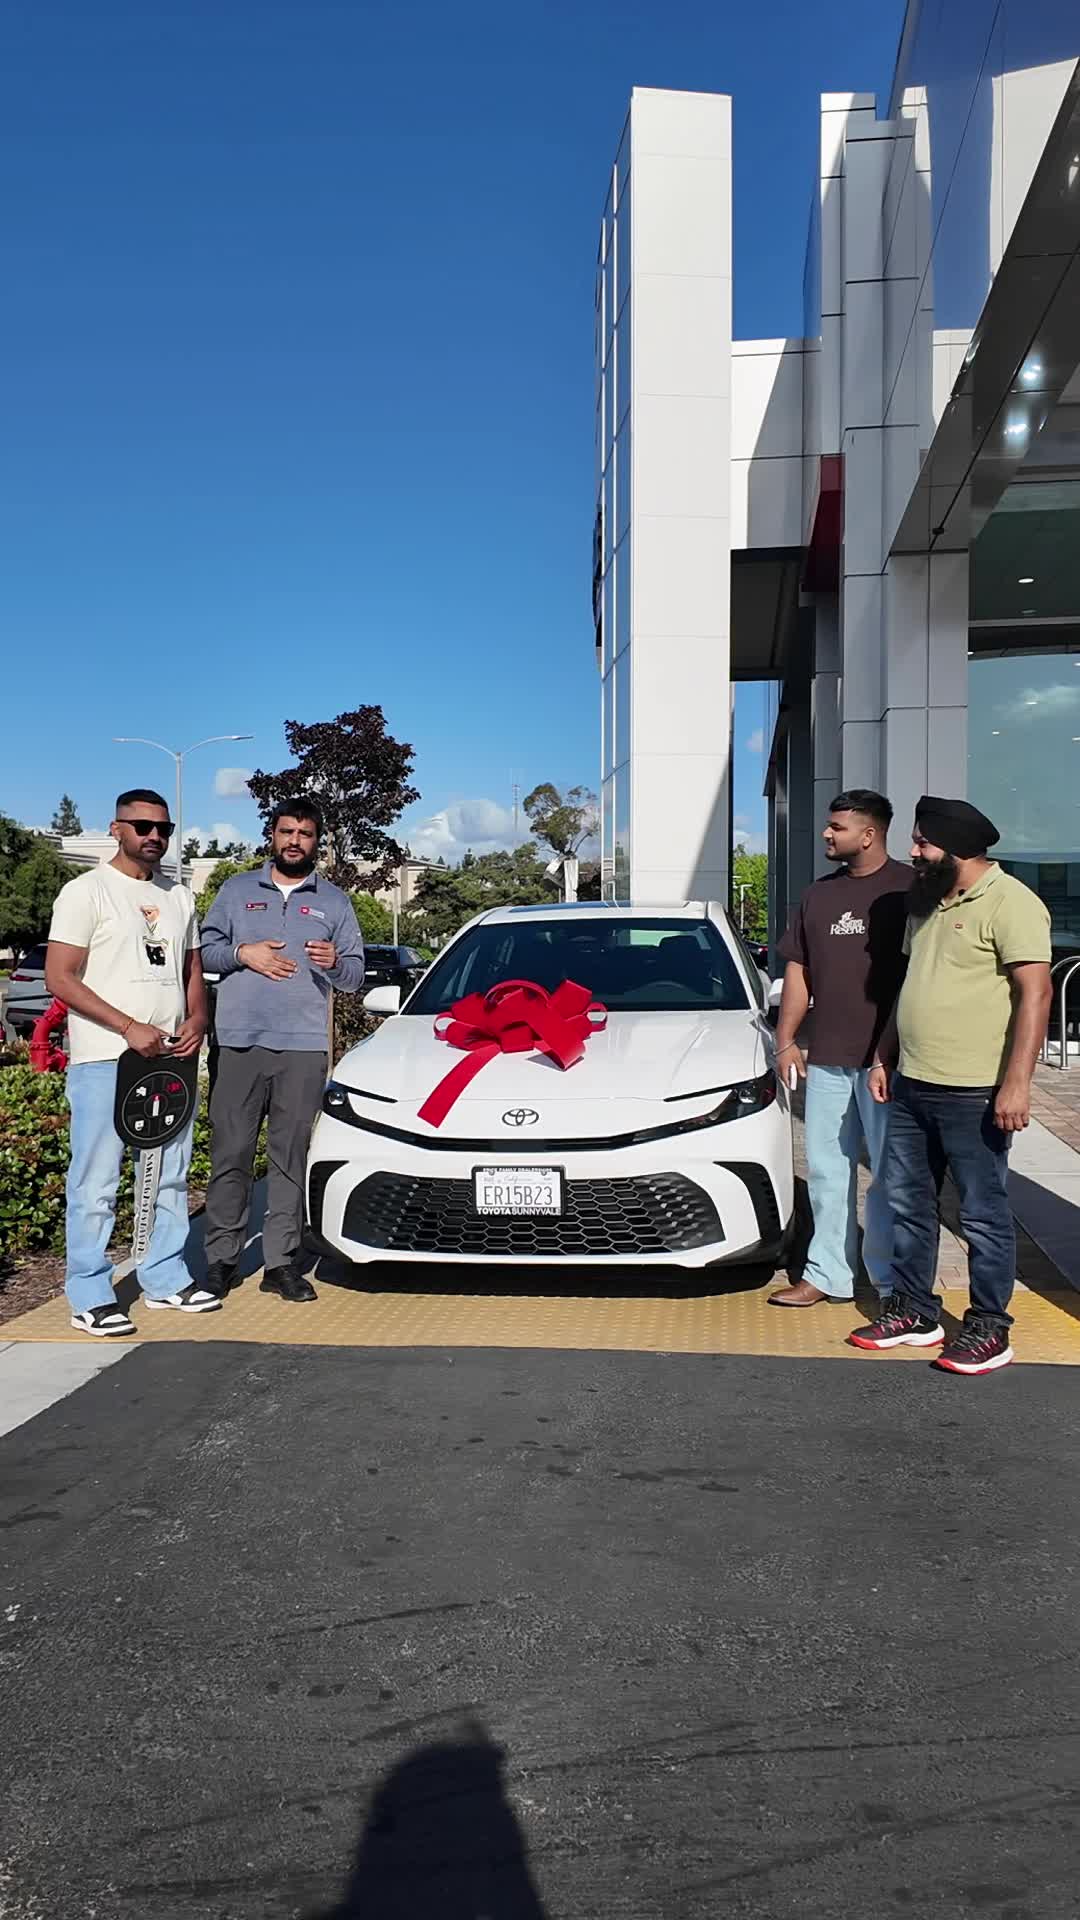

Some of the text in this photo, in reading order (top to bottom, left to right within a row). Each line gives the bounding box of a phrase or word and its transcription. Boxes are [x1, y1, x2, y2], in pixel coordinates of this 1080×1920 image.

[484, 1185, 553, 1205] ER15B23
[477, 1207, 561, 1216] TOYOTA SUNNYVALE
